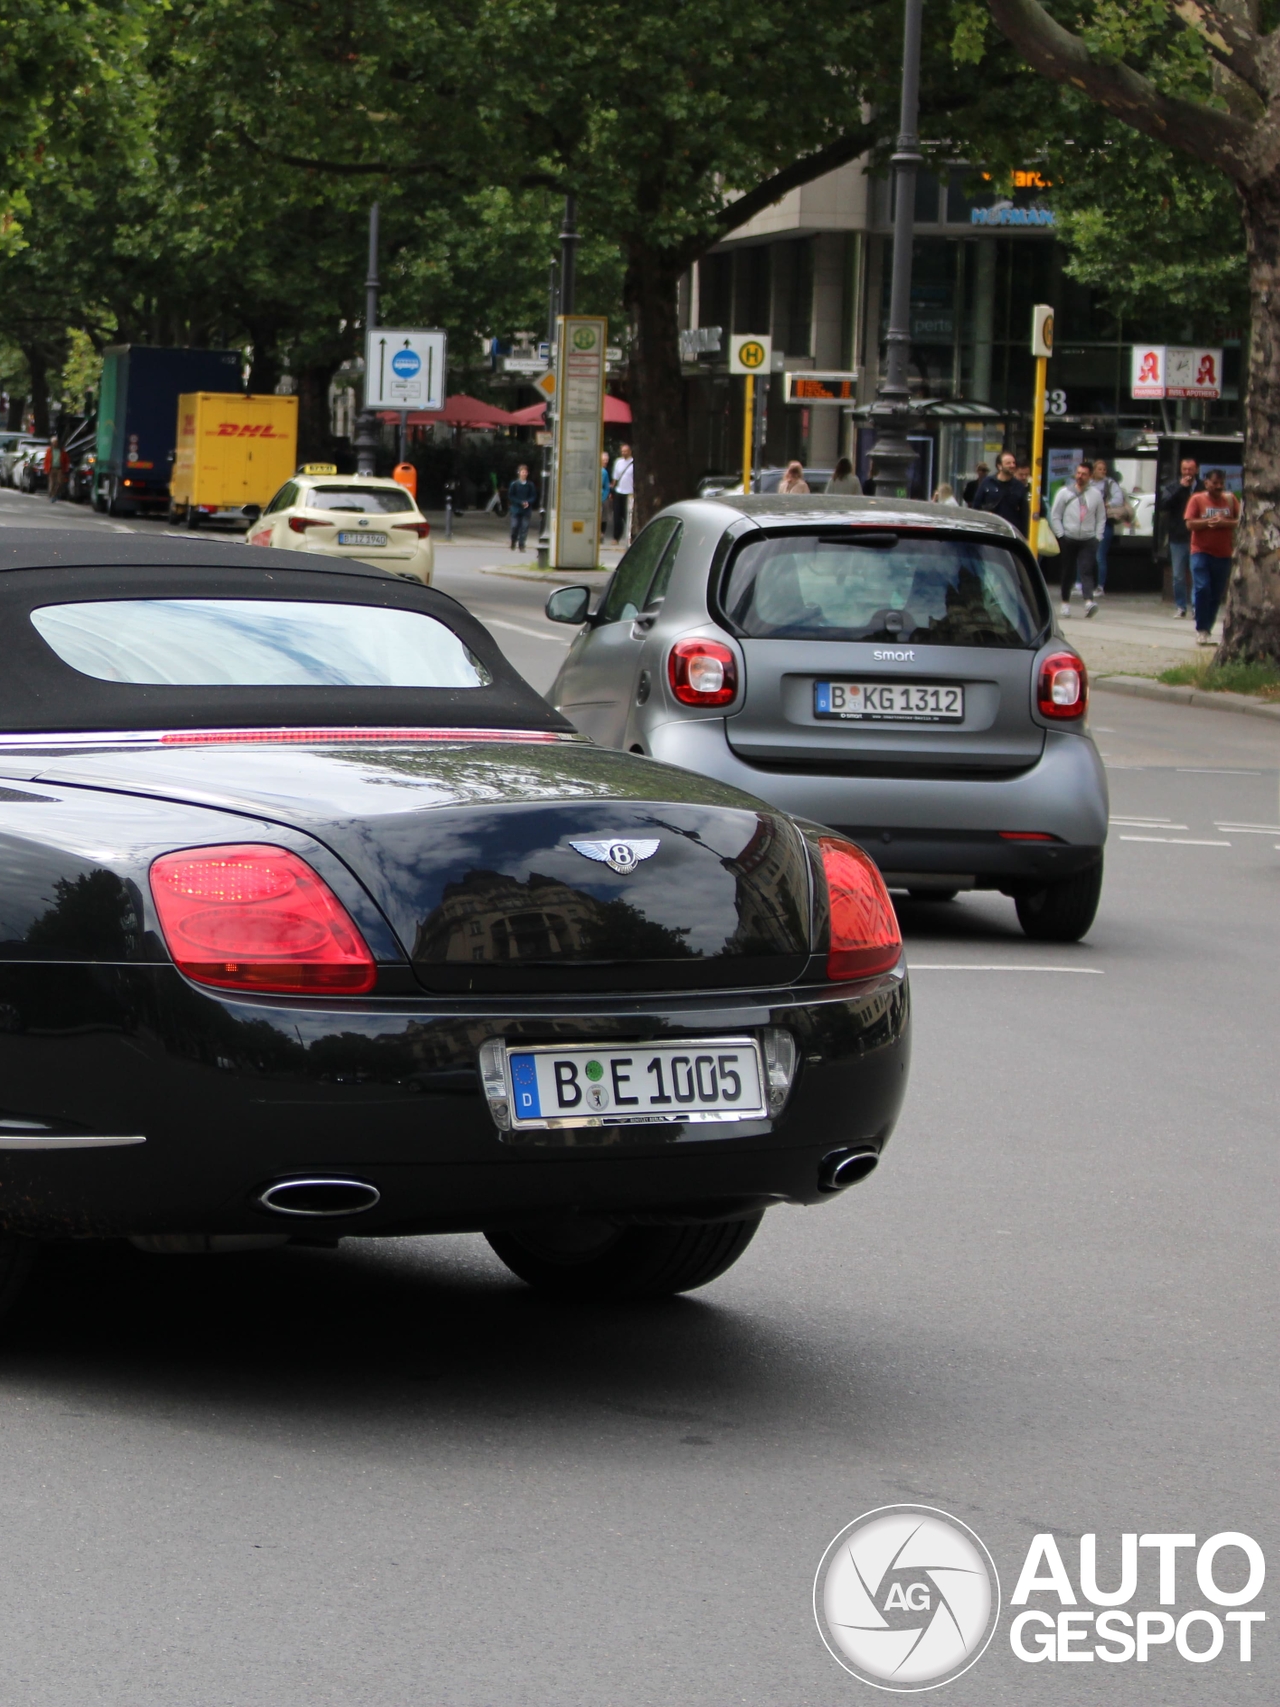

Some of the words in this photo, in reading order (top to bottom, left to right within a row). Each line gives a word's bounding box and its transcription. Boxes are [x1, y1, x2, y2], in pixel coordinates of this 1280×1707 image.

[746, 347, 759, 363] H
[1186, 390, 1216, 398] APOTHEKE
[217, 423, 278, 438] DHL
[873, 650, 916, 662] smart
[832, 686, 846, 709] B
[863, 687, 894, 711] KG
[900, 688, 959, 712] 1312
[612, 844, 632, 864] B
[553, 1060, 583, 1108] B
[610, 1058, 639, 1105] E
[647, 1055, 742, 1104] 1005
[522, 1093, 533, 1107] D
